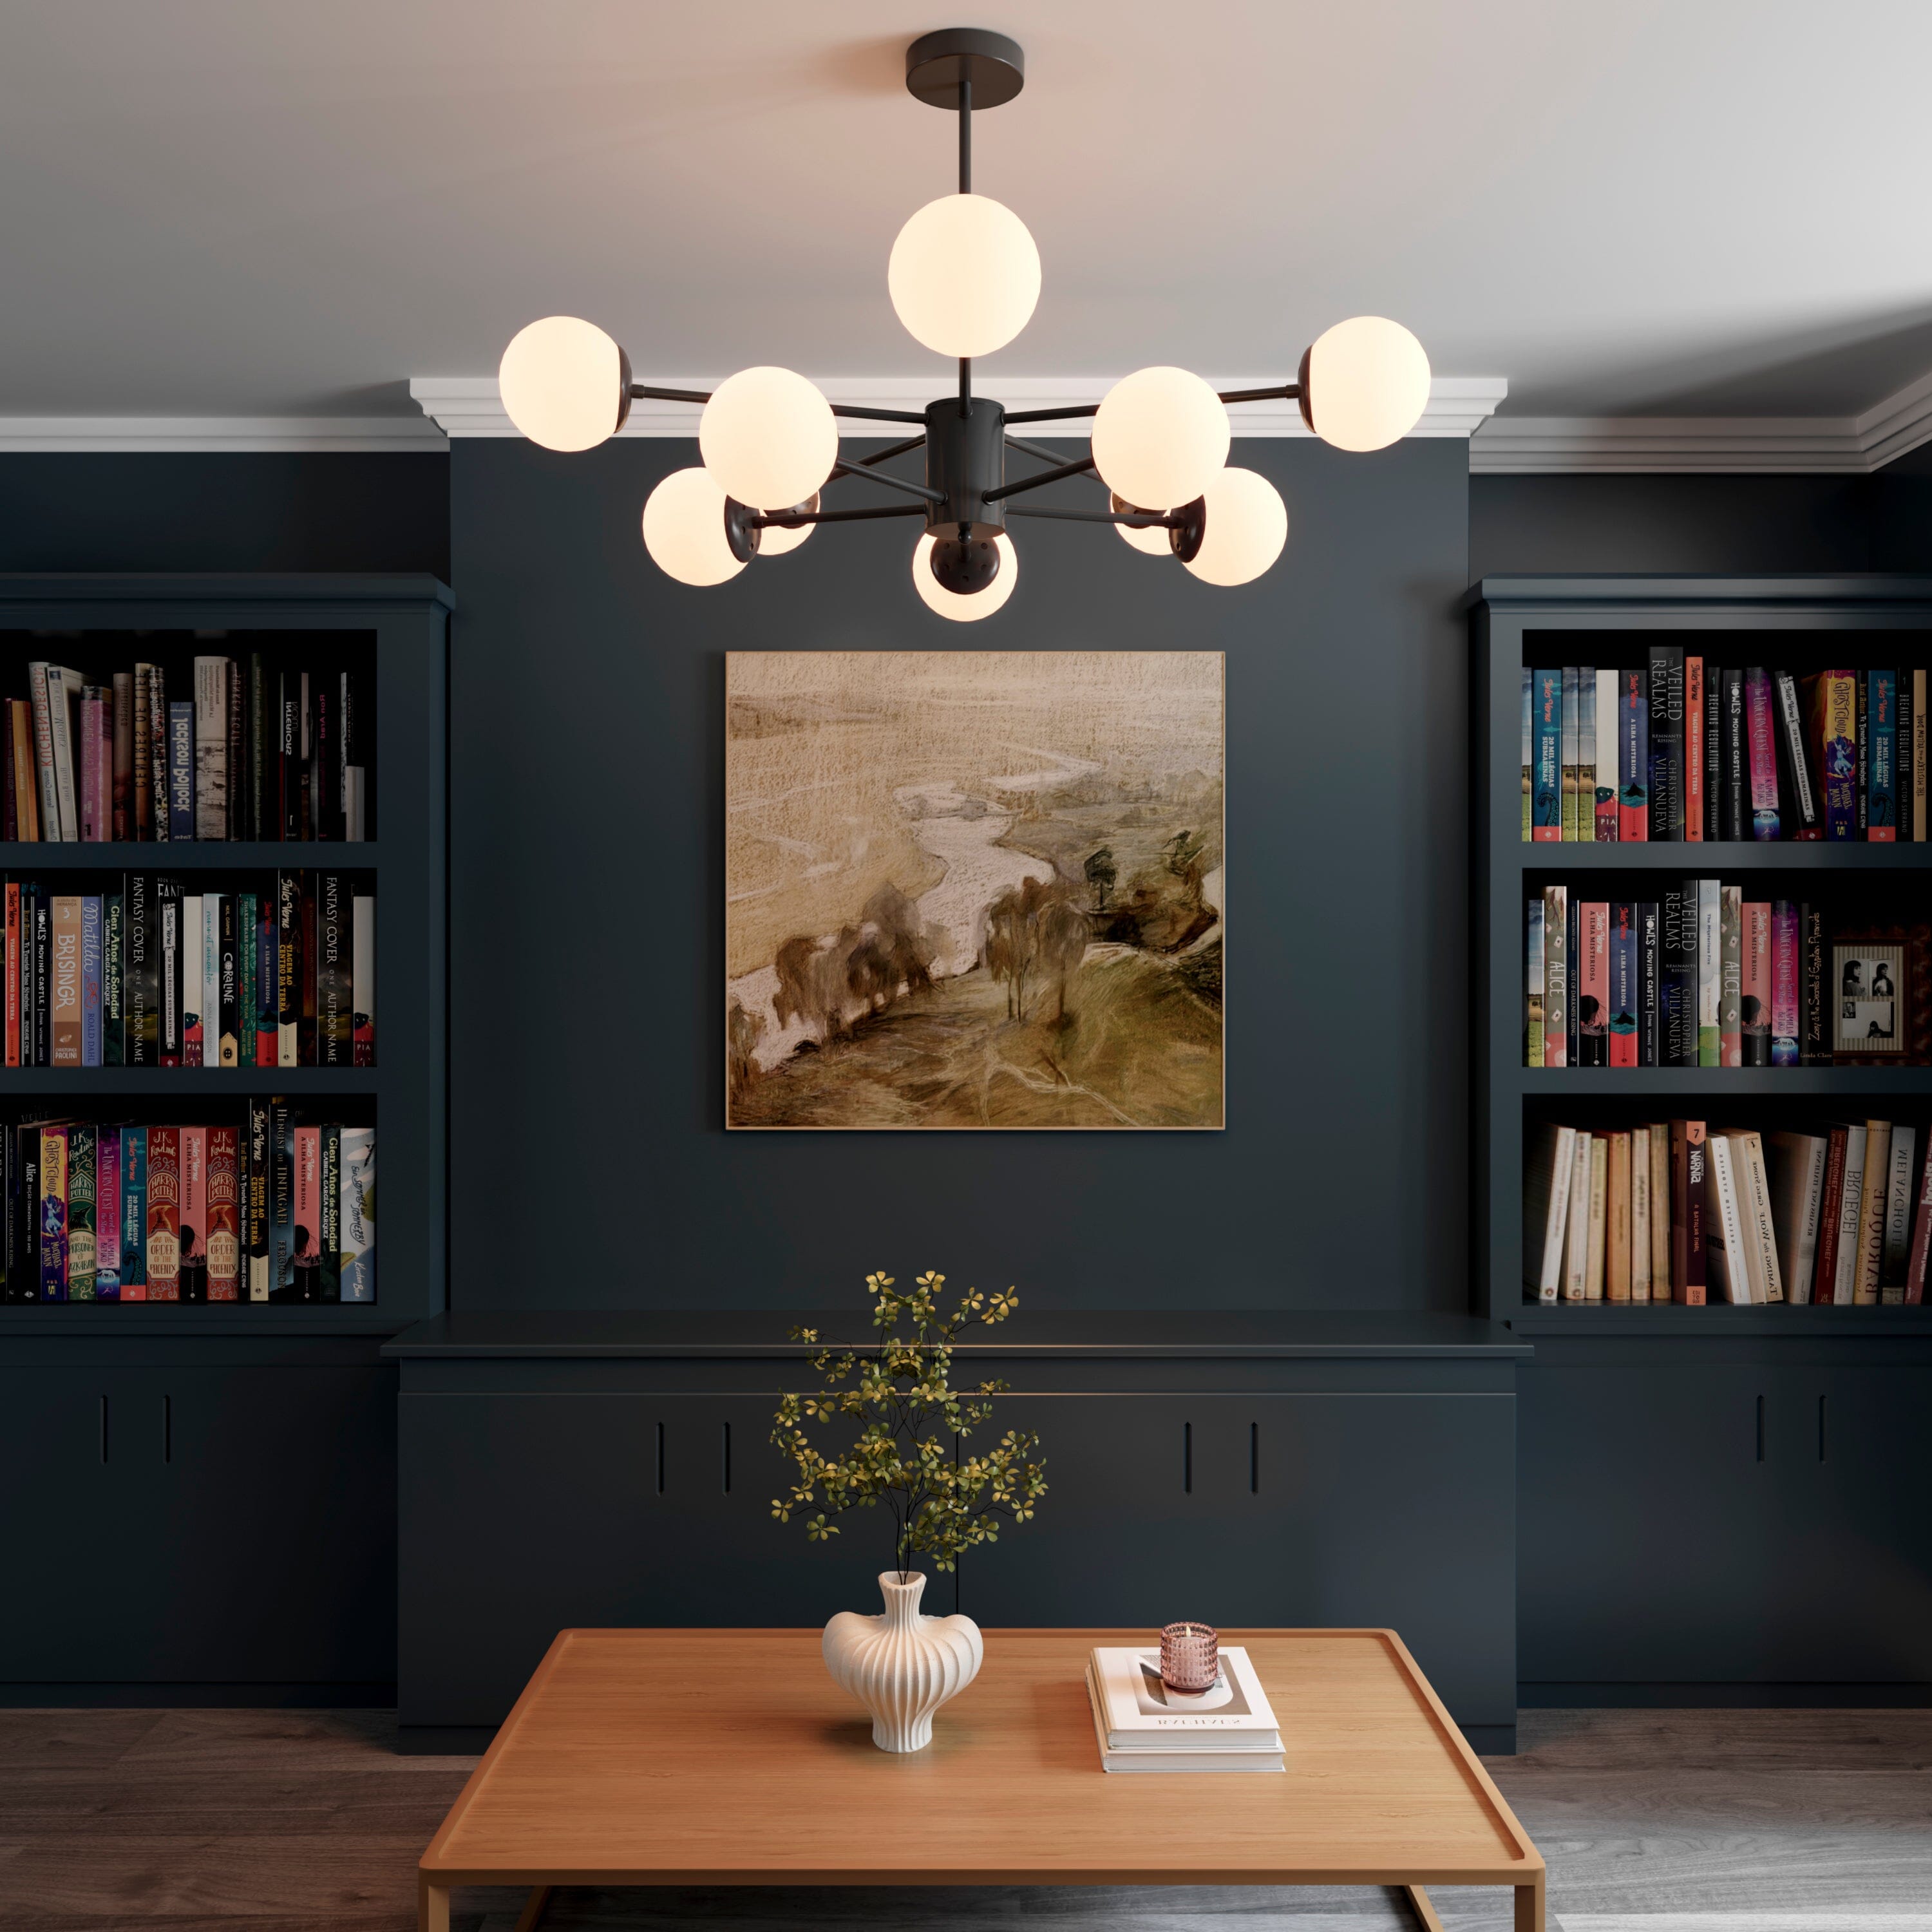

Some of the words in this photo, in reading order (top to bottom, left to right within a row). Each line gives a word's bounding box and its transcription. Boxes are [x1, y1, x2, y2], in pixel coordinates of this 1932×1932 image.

[1652, 659, 1667, 719] REALMS
[1709, 694, 1719, 725] BREAKING
[1549, 737, 1554, 745] 20
[1709, 730, 1719, 772] REGULATIONS
[1655, 757, 1667, 832] VILLANUEVA
[1669, 760, 1677, 831] CHRISTOPHER
[1799, 773, 1810, 810] SUBMARINAS
[134, 877, 144, 923] FANTASY
[281, 878, 293, 902] Jules
[281, 903, 292, 929] Verne
[1596, 912, 1605, 931] Jules
[1665, 893, 1680, 949] REALMS
[1681, 898, 1696, 951] VEILED
[84, 903, 100, 972] Matilda
[133, 926, 144, 964] COVER
[55, 933, 75, 1010] BRISINGR
[279, 976, 286, 986] DA
[287, 975, 292, 985] AO
[1549, 961, 1564, 998] ALICE
[1724, 961, 1740, 998] ALICE
[134, 992, 143, 1031] AUTHOR
[1669, 987, 1680, 1059] VILLANUEVA
[1682, 989, 1691, 1057] CHRISTOPHER
[134, 1034, 143, 1063] NAME
[252, 1110, 265, 1134] Jules
[1694, 1130, 1700, 1139] 7
[254, 1135, 264, 1161] Verne
[152, 1174, 174, 1188] HARRY
[152, 1186, 174, 1198] POTTER
[133, 1195, 138, 1204] 20
[251, 1209, 258, 1220] DA
[258, 1208, 265, 1218] AO
[8, 1211, 14, 1219] OF
[151, 1244, 175, 1255] ORDER
[278, 1240, 287, 1289] FERGUSON
[150, 1264, 176, 1274] PHOENIX
